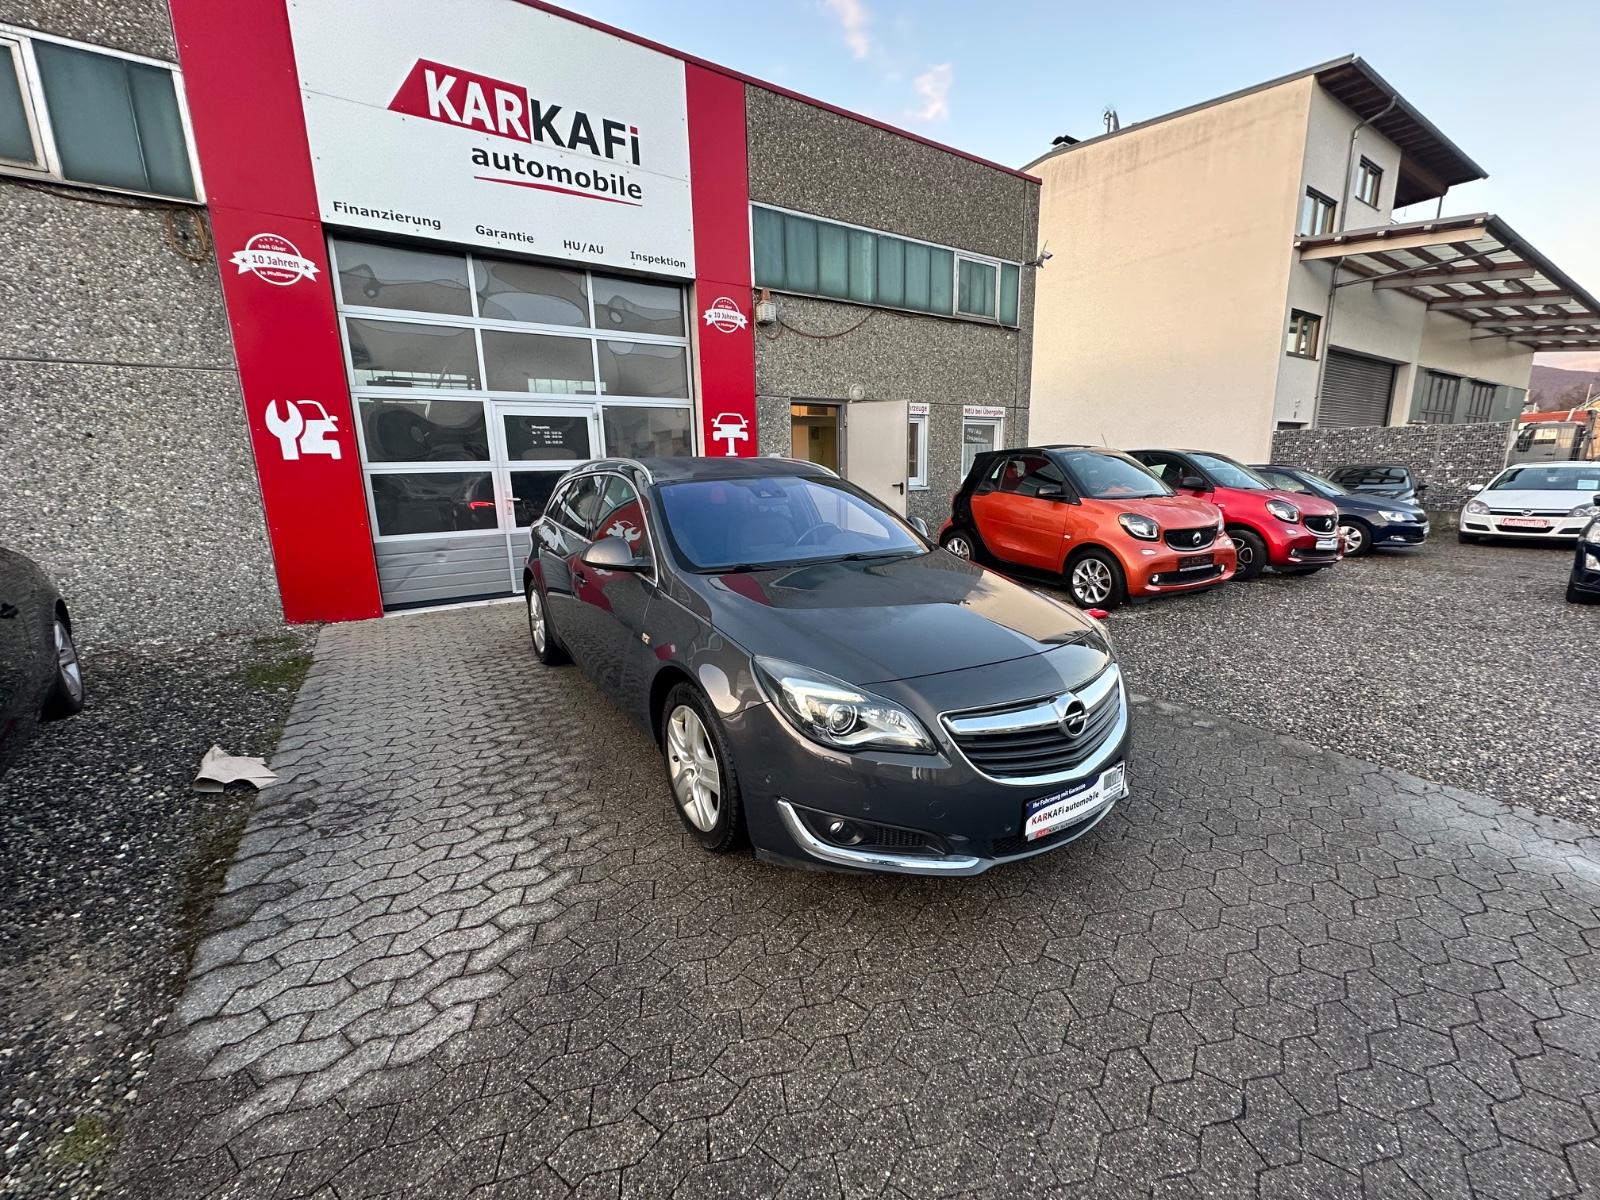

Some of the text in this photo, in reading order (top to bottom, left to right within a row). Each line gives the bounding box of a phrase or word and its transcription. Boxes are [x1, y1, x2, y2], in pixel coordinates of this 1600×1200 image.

[471, 147, 642, 200] automobile
[333, 200, 442, 231] Finanzierung
[475, 224, 535, 244] Garantie
[563, 239, 605, 255] HU/AU
[252, 255, 299, 268] 10 Jahren
[630, 251, 687, 269] Inspektion
[1040, 794, 1061, 806] Fahrzeug
[1065, 791, 1099, 812] automobile
